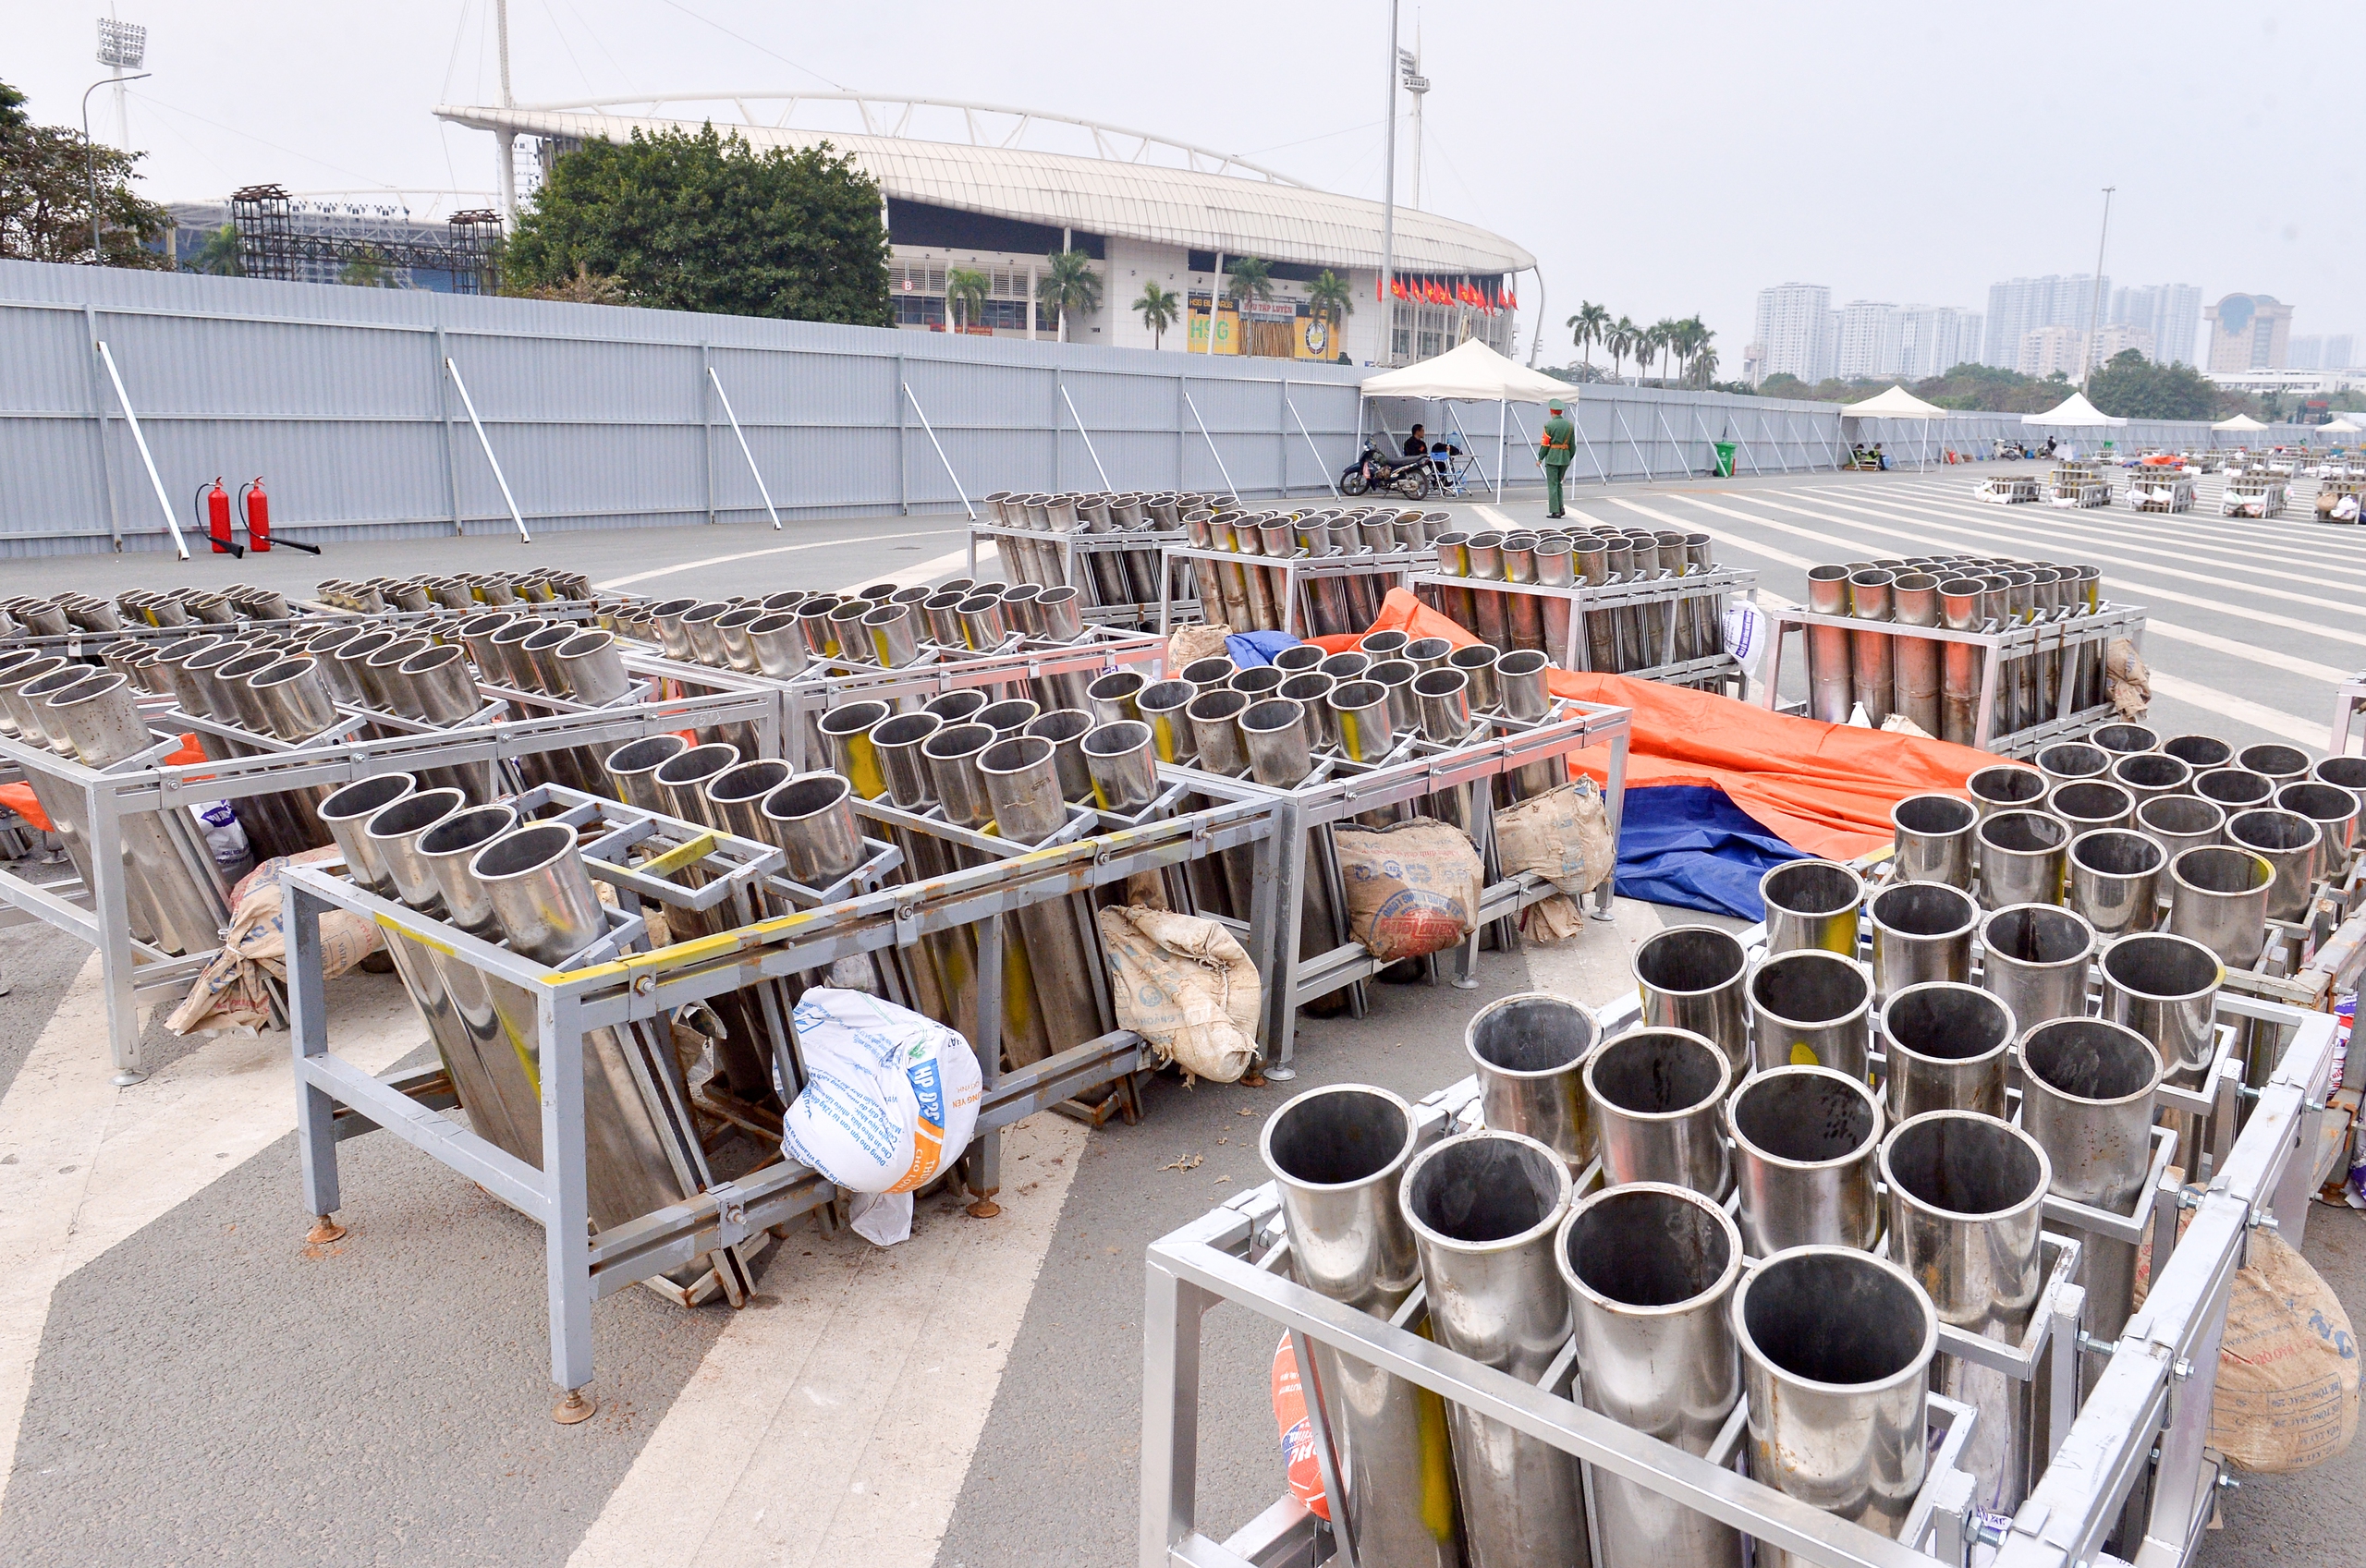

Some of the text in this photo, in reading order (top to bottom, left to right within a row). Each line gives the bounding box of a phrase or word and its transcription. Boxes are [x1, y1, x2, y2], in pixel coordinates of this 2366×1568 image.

[904, 280, 912, 291] B
[914, 1065, 934, 1088] HP
[818, 1100, 833, 1115] 12kg
[839, 1119, 850, 1131] con
[860, 1125, 874, 1141] theo
[793, 1137, 815, 1161] vitamin
[859, 1137, 871, 1151] cho
[868, 1148, 885, 1167] Dùng
[879, 1146, 892, 1160] Cho
[912, 1148, 923, 1173] CHO
[814, 1159, 829, 1173] sung
